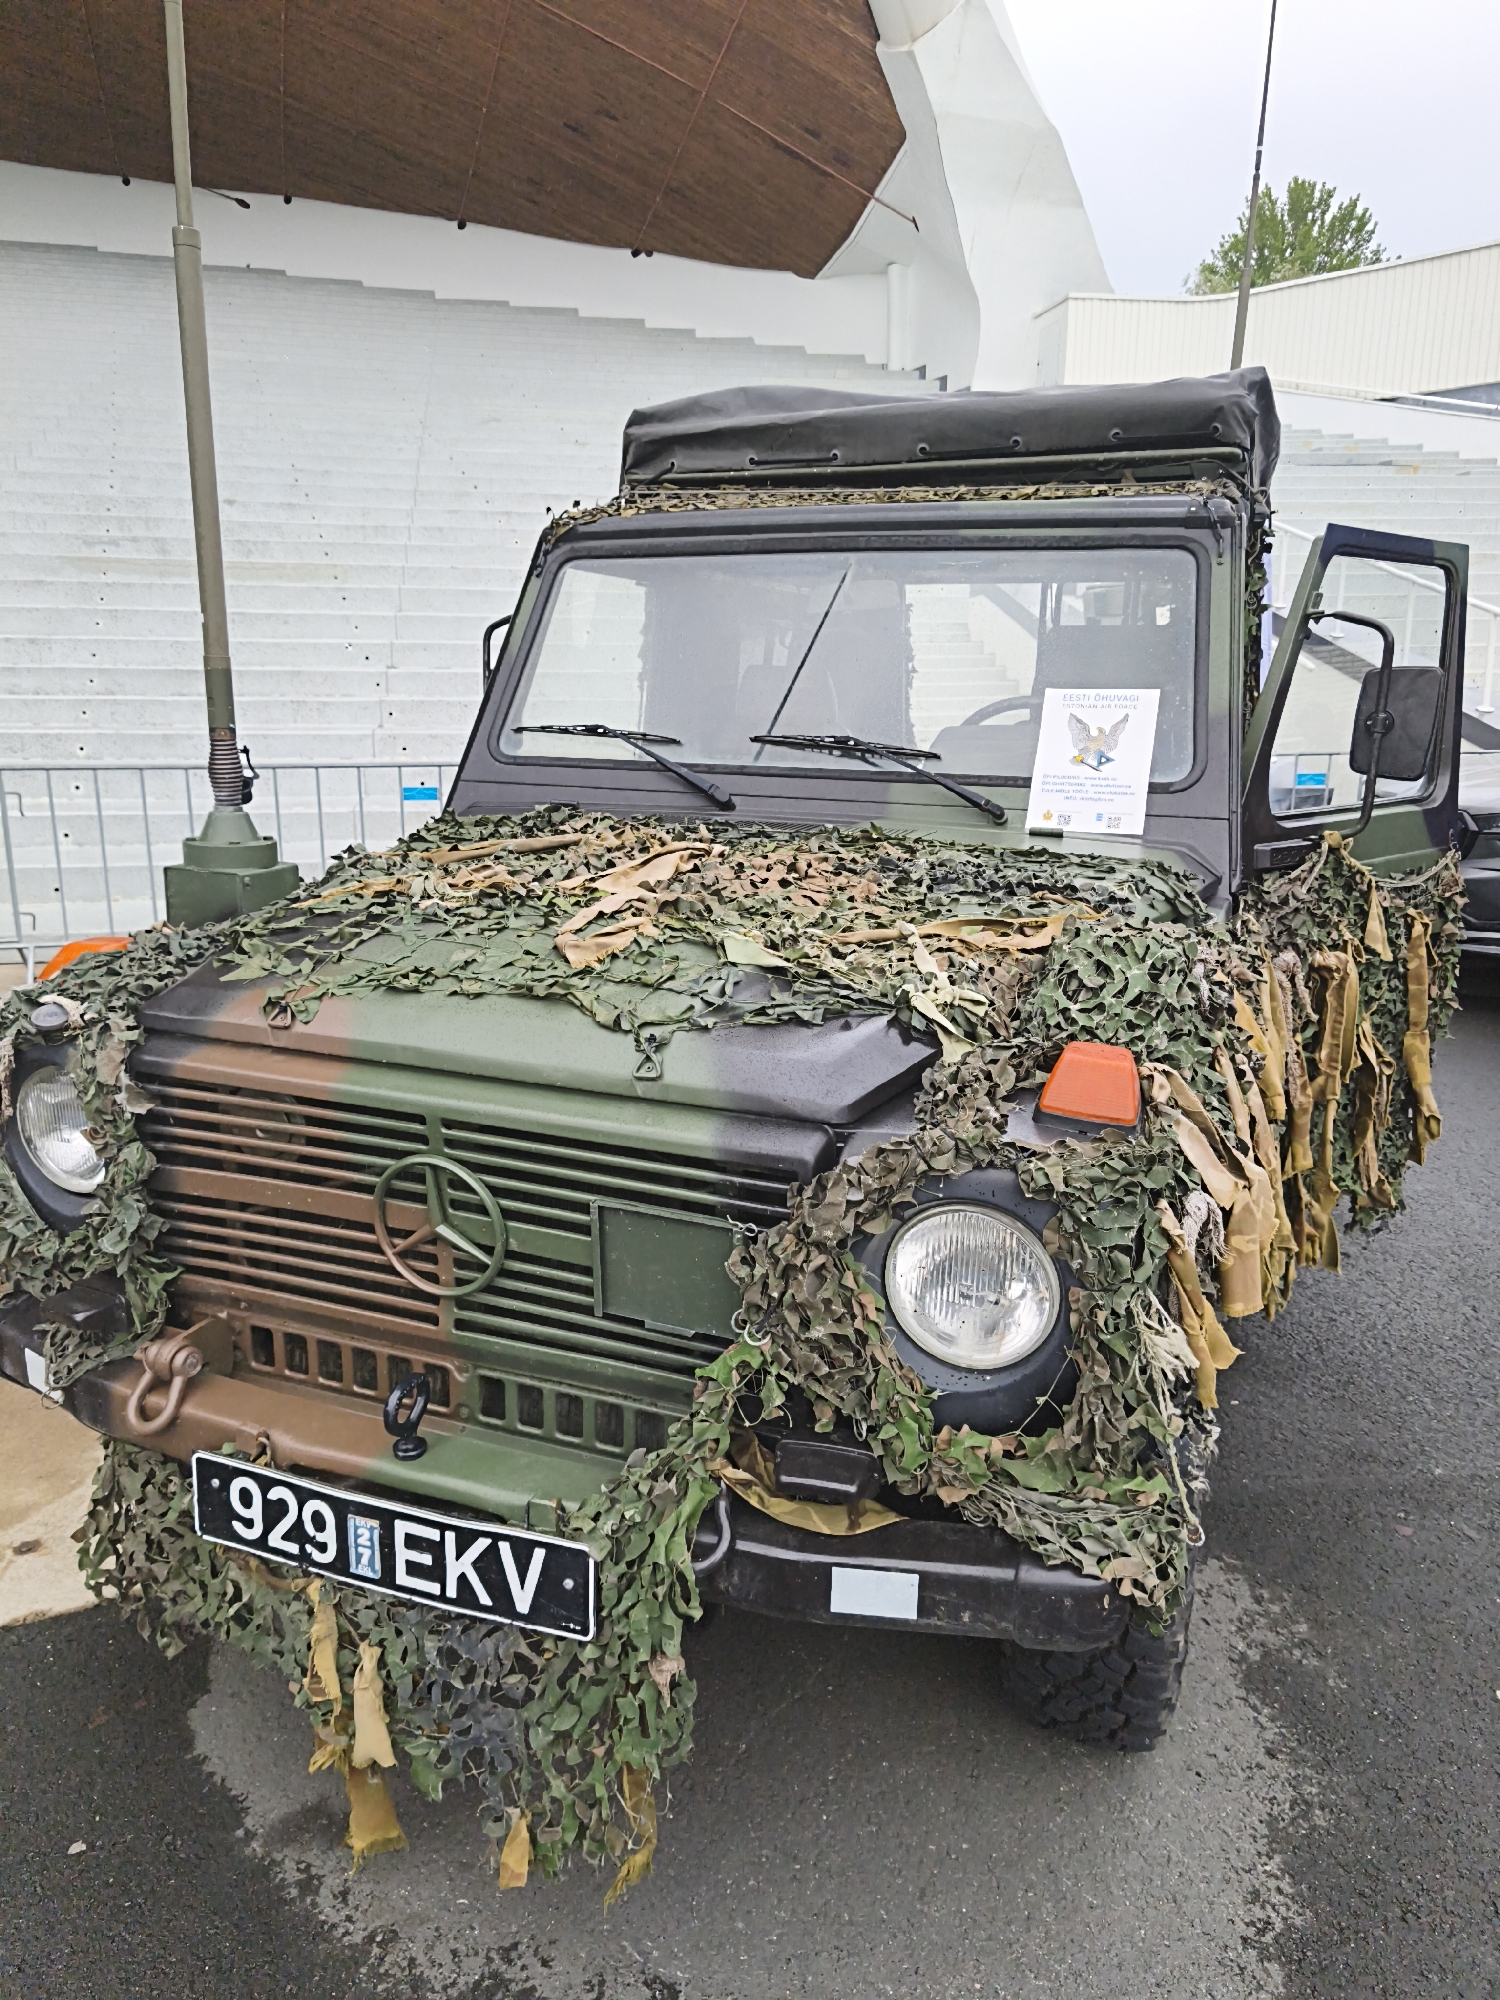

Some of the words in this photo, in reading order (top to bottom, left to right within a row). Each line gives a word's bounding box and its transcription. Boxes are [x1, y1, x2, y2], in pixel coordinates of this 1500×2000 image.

[1062, 693, 1090, 702] EESTI
[229, 1476, 337, 1564] 929
[394, 1519, 546, 1614] EKV
